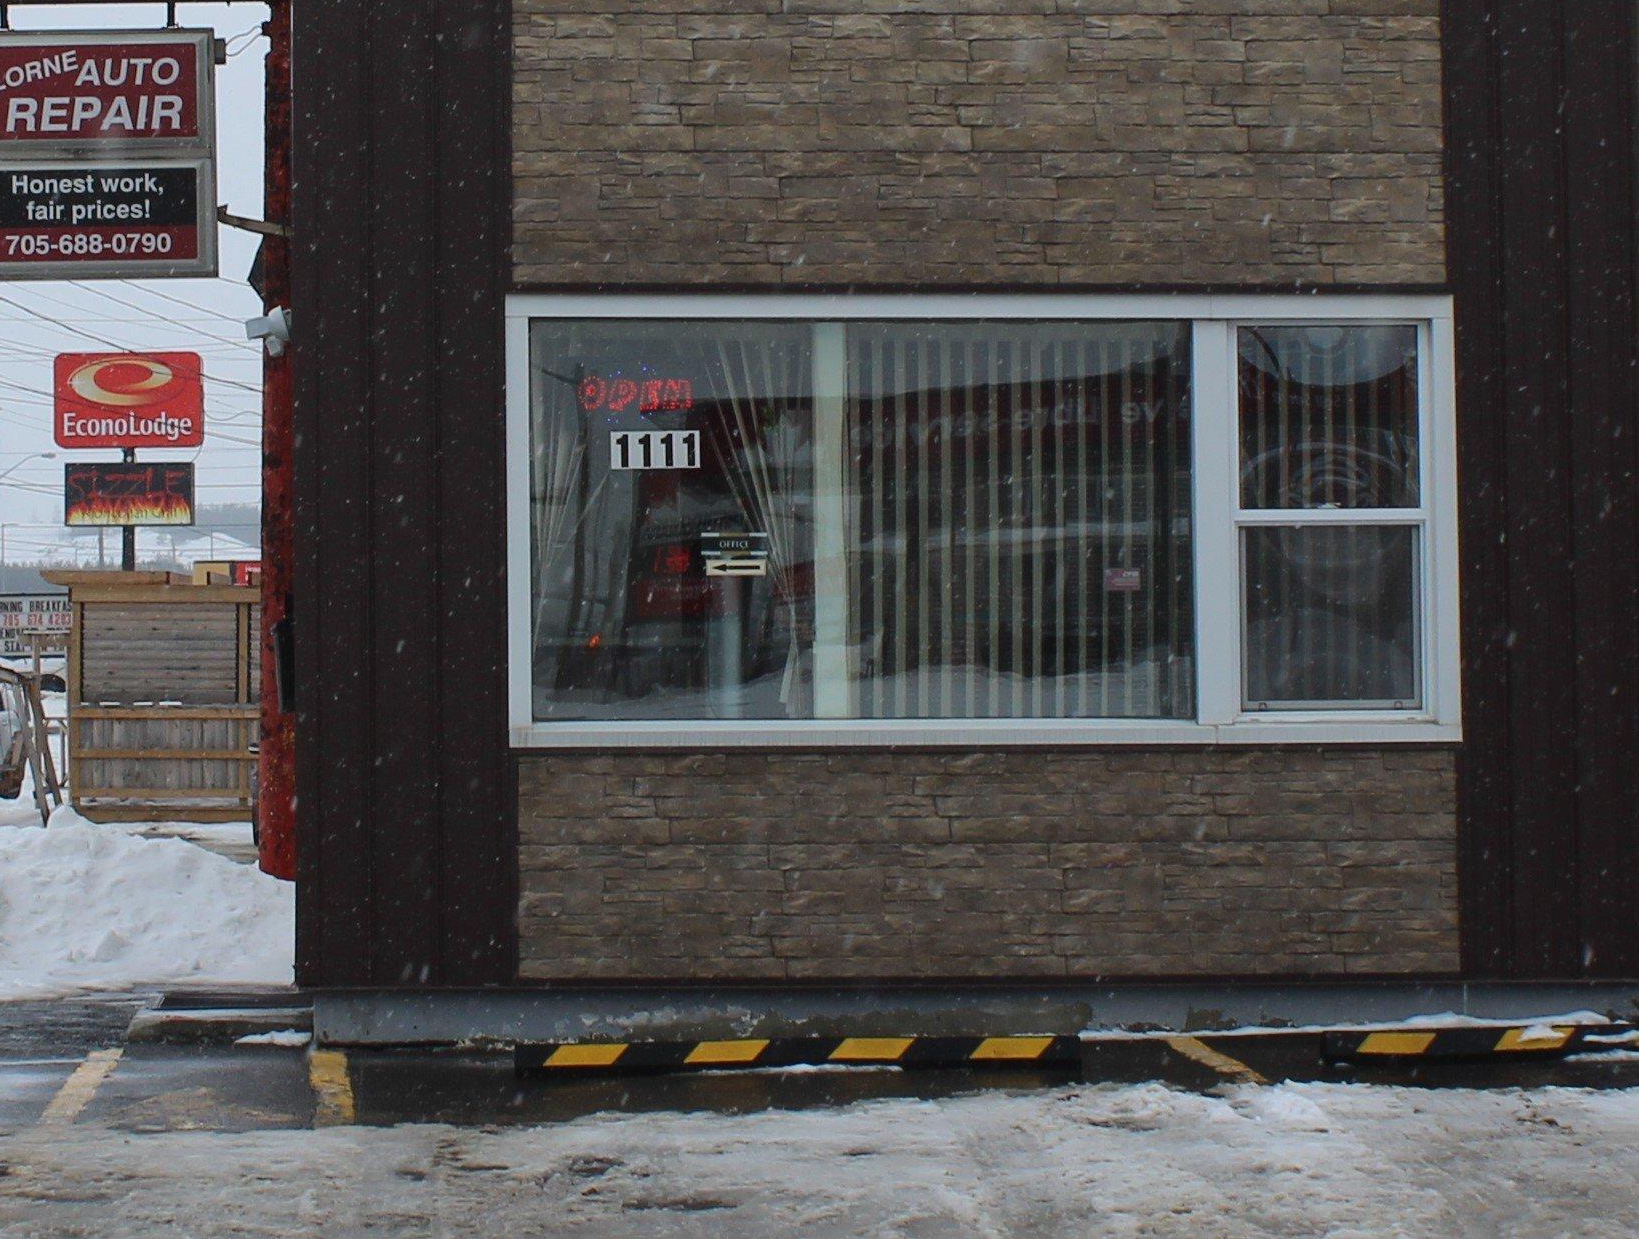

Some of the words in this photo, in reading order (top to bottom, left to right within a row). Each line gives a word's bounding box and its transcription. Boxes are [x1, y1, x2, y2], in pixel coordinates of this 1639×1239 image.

[74, 57, 181, 88] AUTO
[5, 95, 184, 133] REPAIR
[11, 175, 94, 195] Honest
[101, 174, 164, 195] work,
[26, 199, 65, 221] fair
[71, 199, 151, 224] prices!
[4, 233, 172, 255] 705-688-0790
[63, 411, 193, 441] EconoLodge
[615, 432, 696, 468] 1111
[29, 600, 73, 613] BREAKFAS
